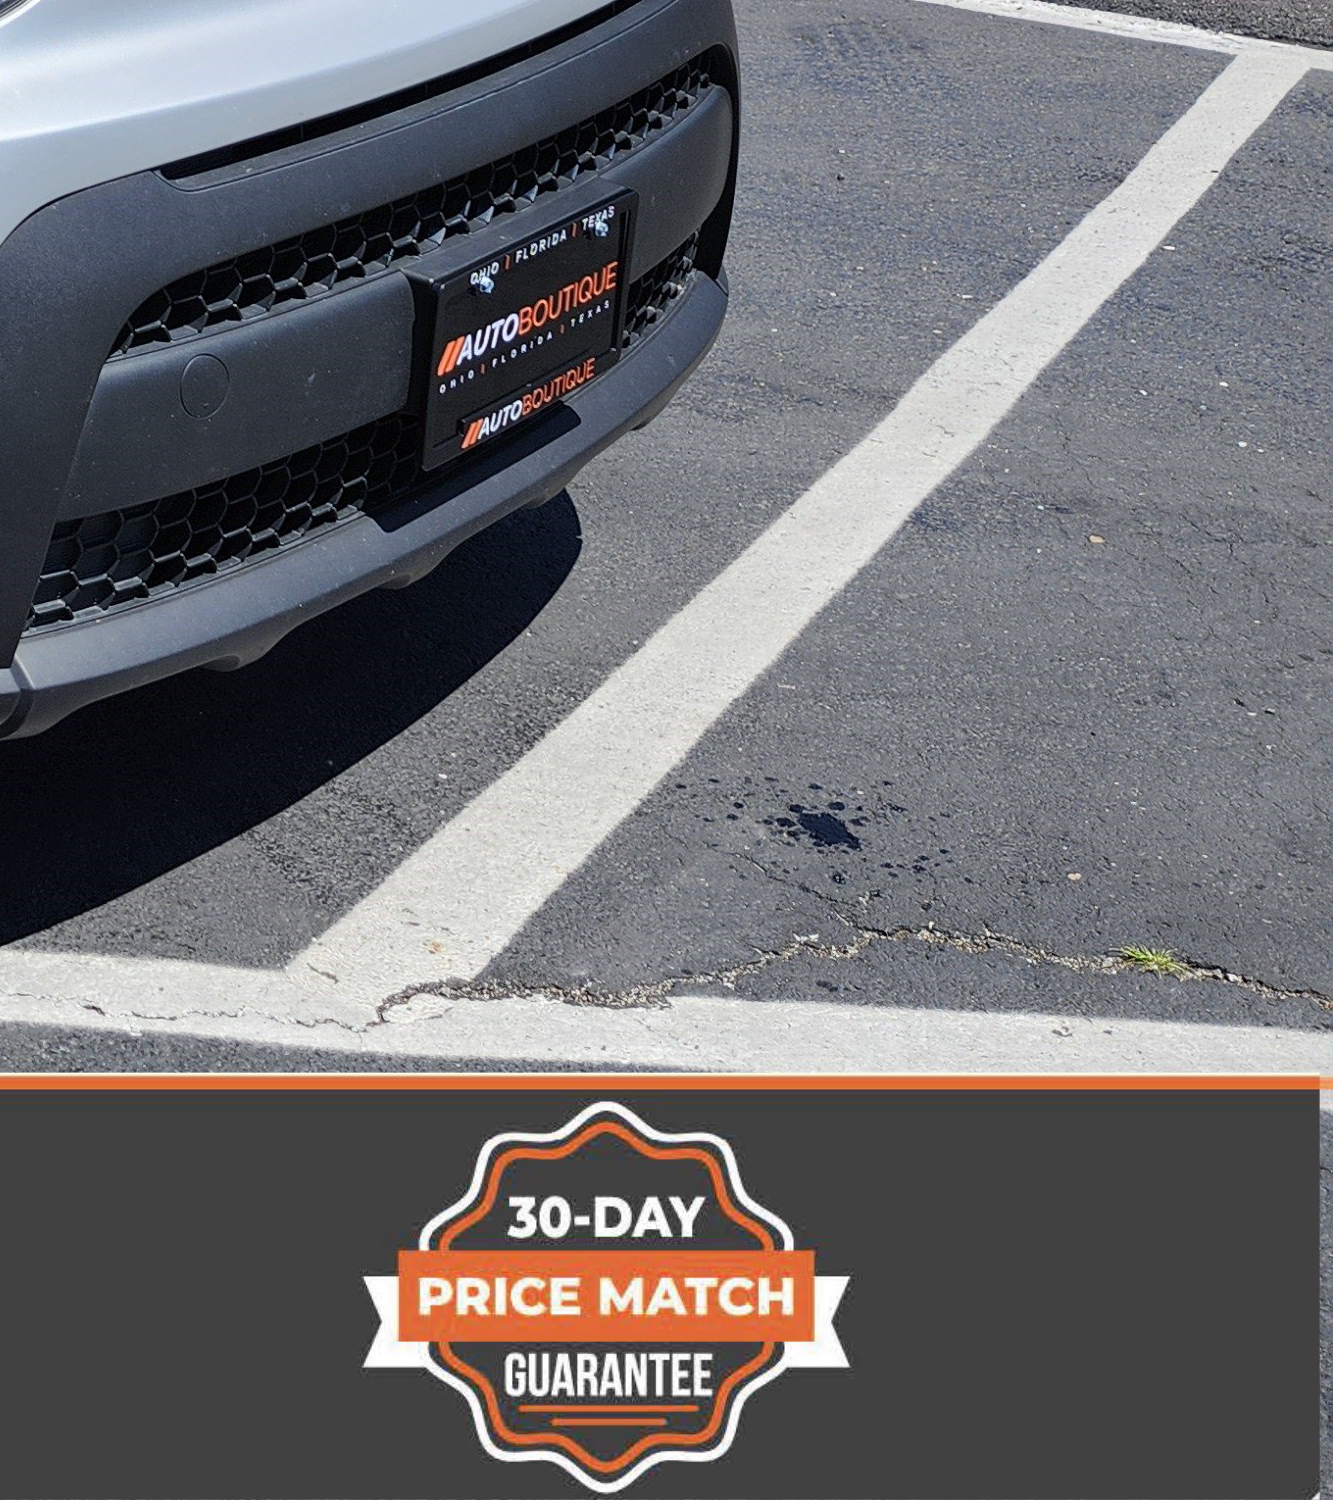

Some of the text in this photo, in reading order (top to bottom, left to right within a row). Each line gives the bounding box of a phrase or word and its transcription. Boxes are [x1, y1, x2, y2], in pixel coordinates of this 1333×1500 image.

[470, 205, 616, 286] OHIO FLORIDA TEXAS
[439, 300, 610, 394] OHIO FLORIDA TEXAS
[455, 261, 619, 366] AUTOBOUTIQUE
[477, 357, 596, 440] AUTOBOUTIQUE
